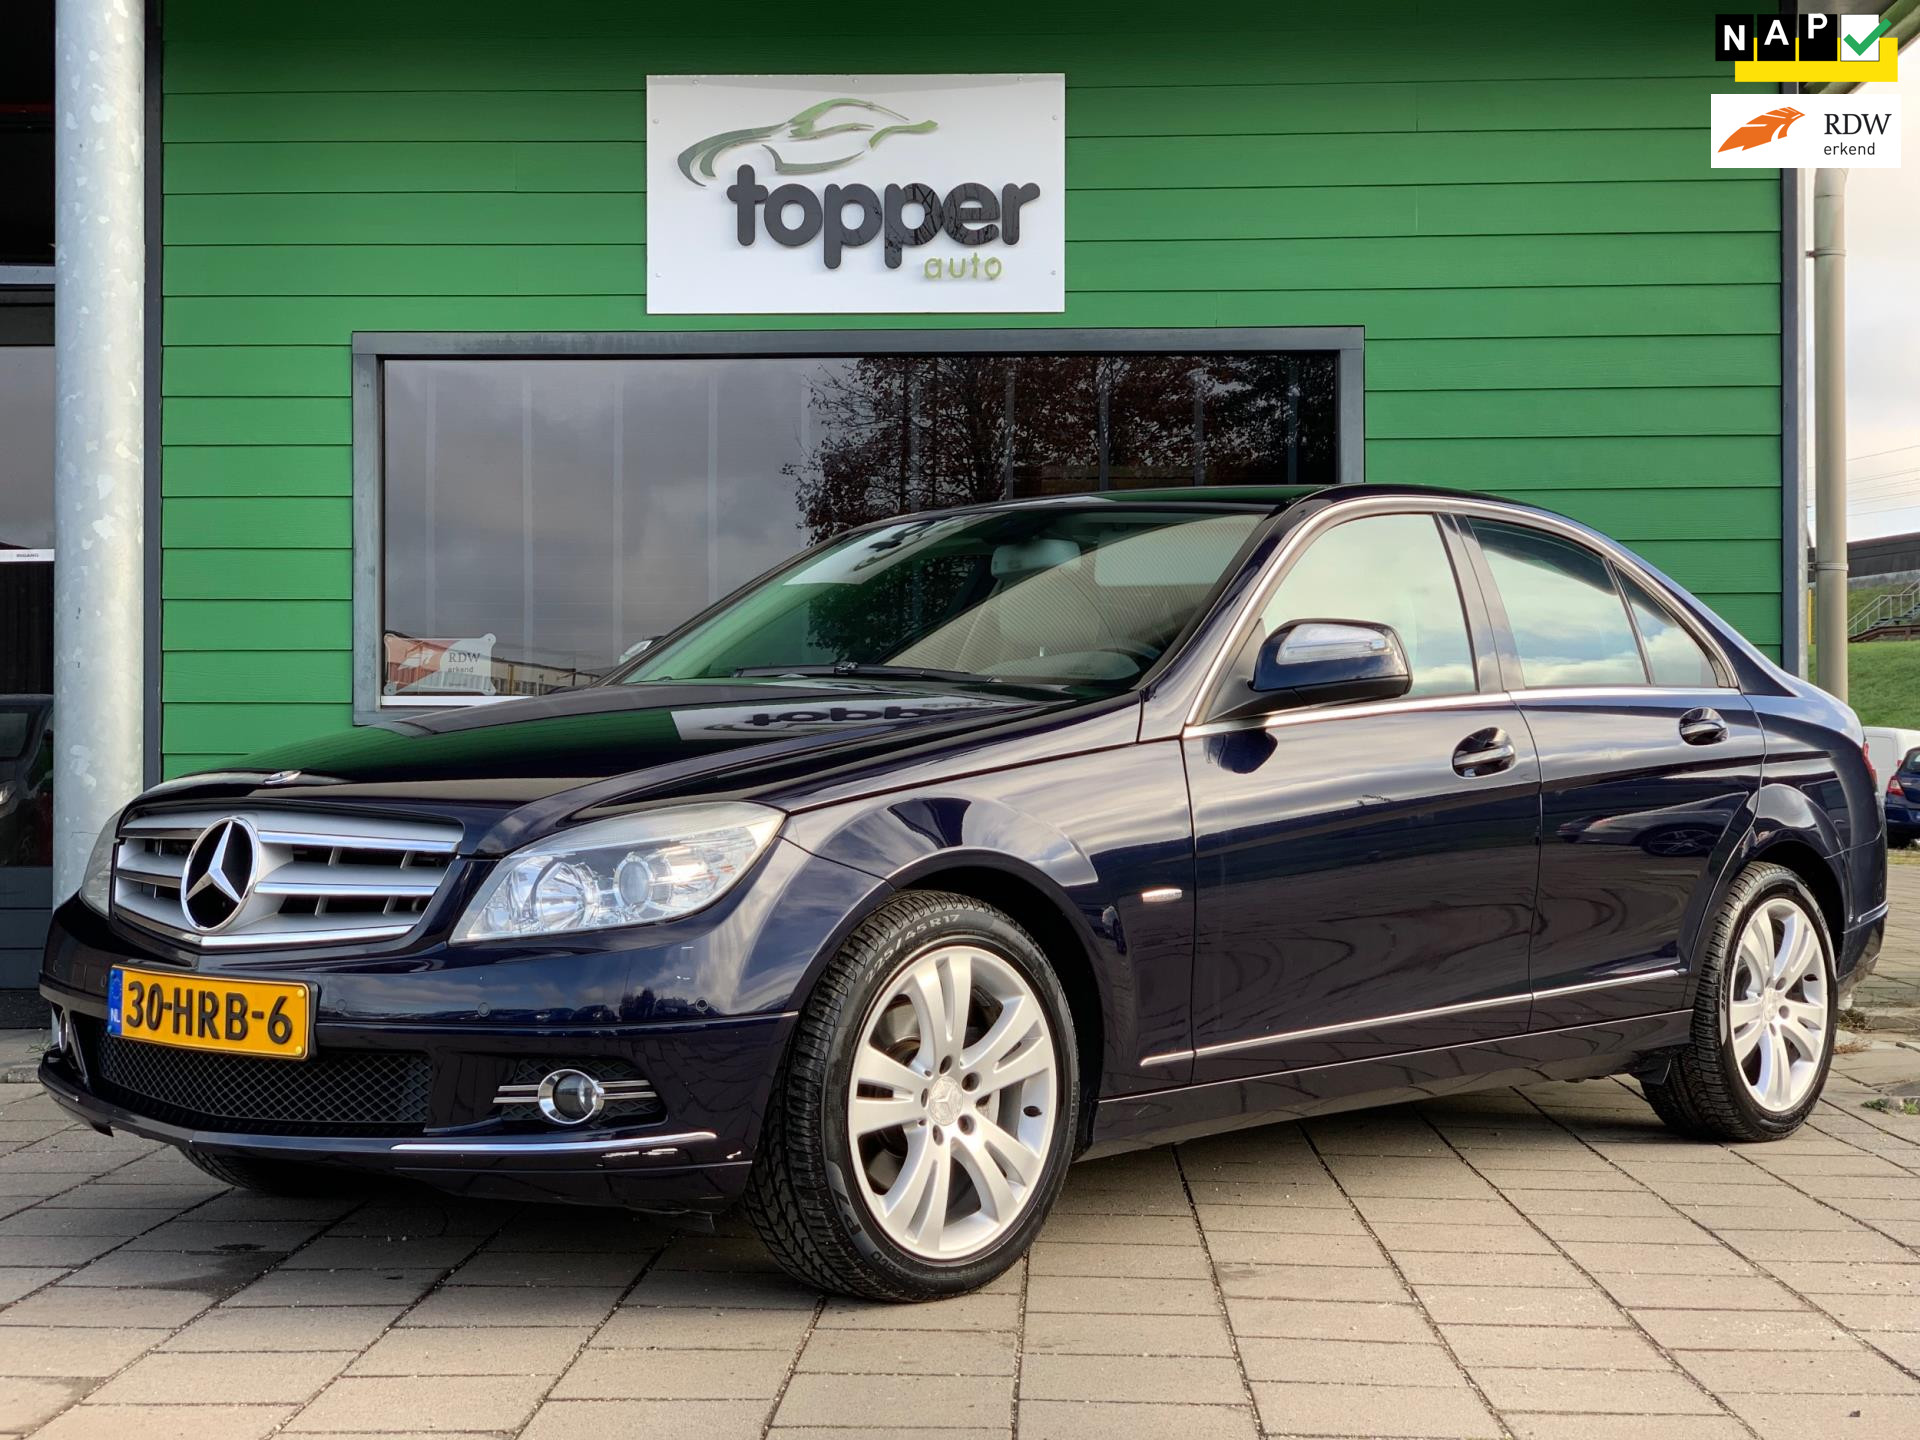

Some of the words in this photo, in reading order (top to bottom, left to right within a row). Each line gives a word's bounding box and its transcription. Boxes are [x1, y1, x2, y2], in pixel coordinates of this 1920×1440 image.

[726, 164, 1040, 269] topper
[923, 253, 1002, 280] auto
[448, 652, 480, 662] RDW
[110, 1007, 121, 1023] NL
[126, 980, 292, 1045] 30-HRB-6
